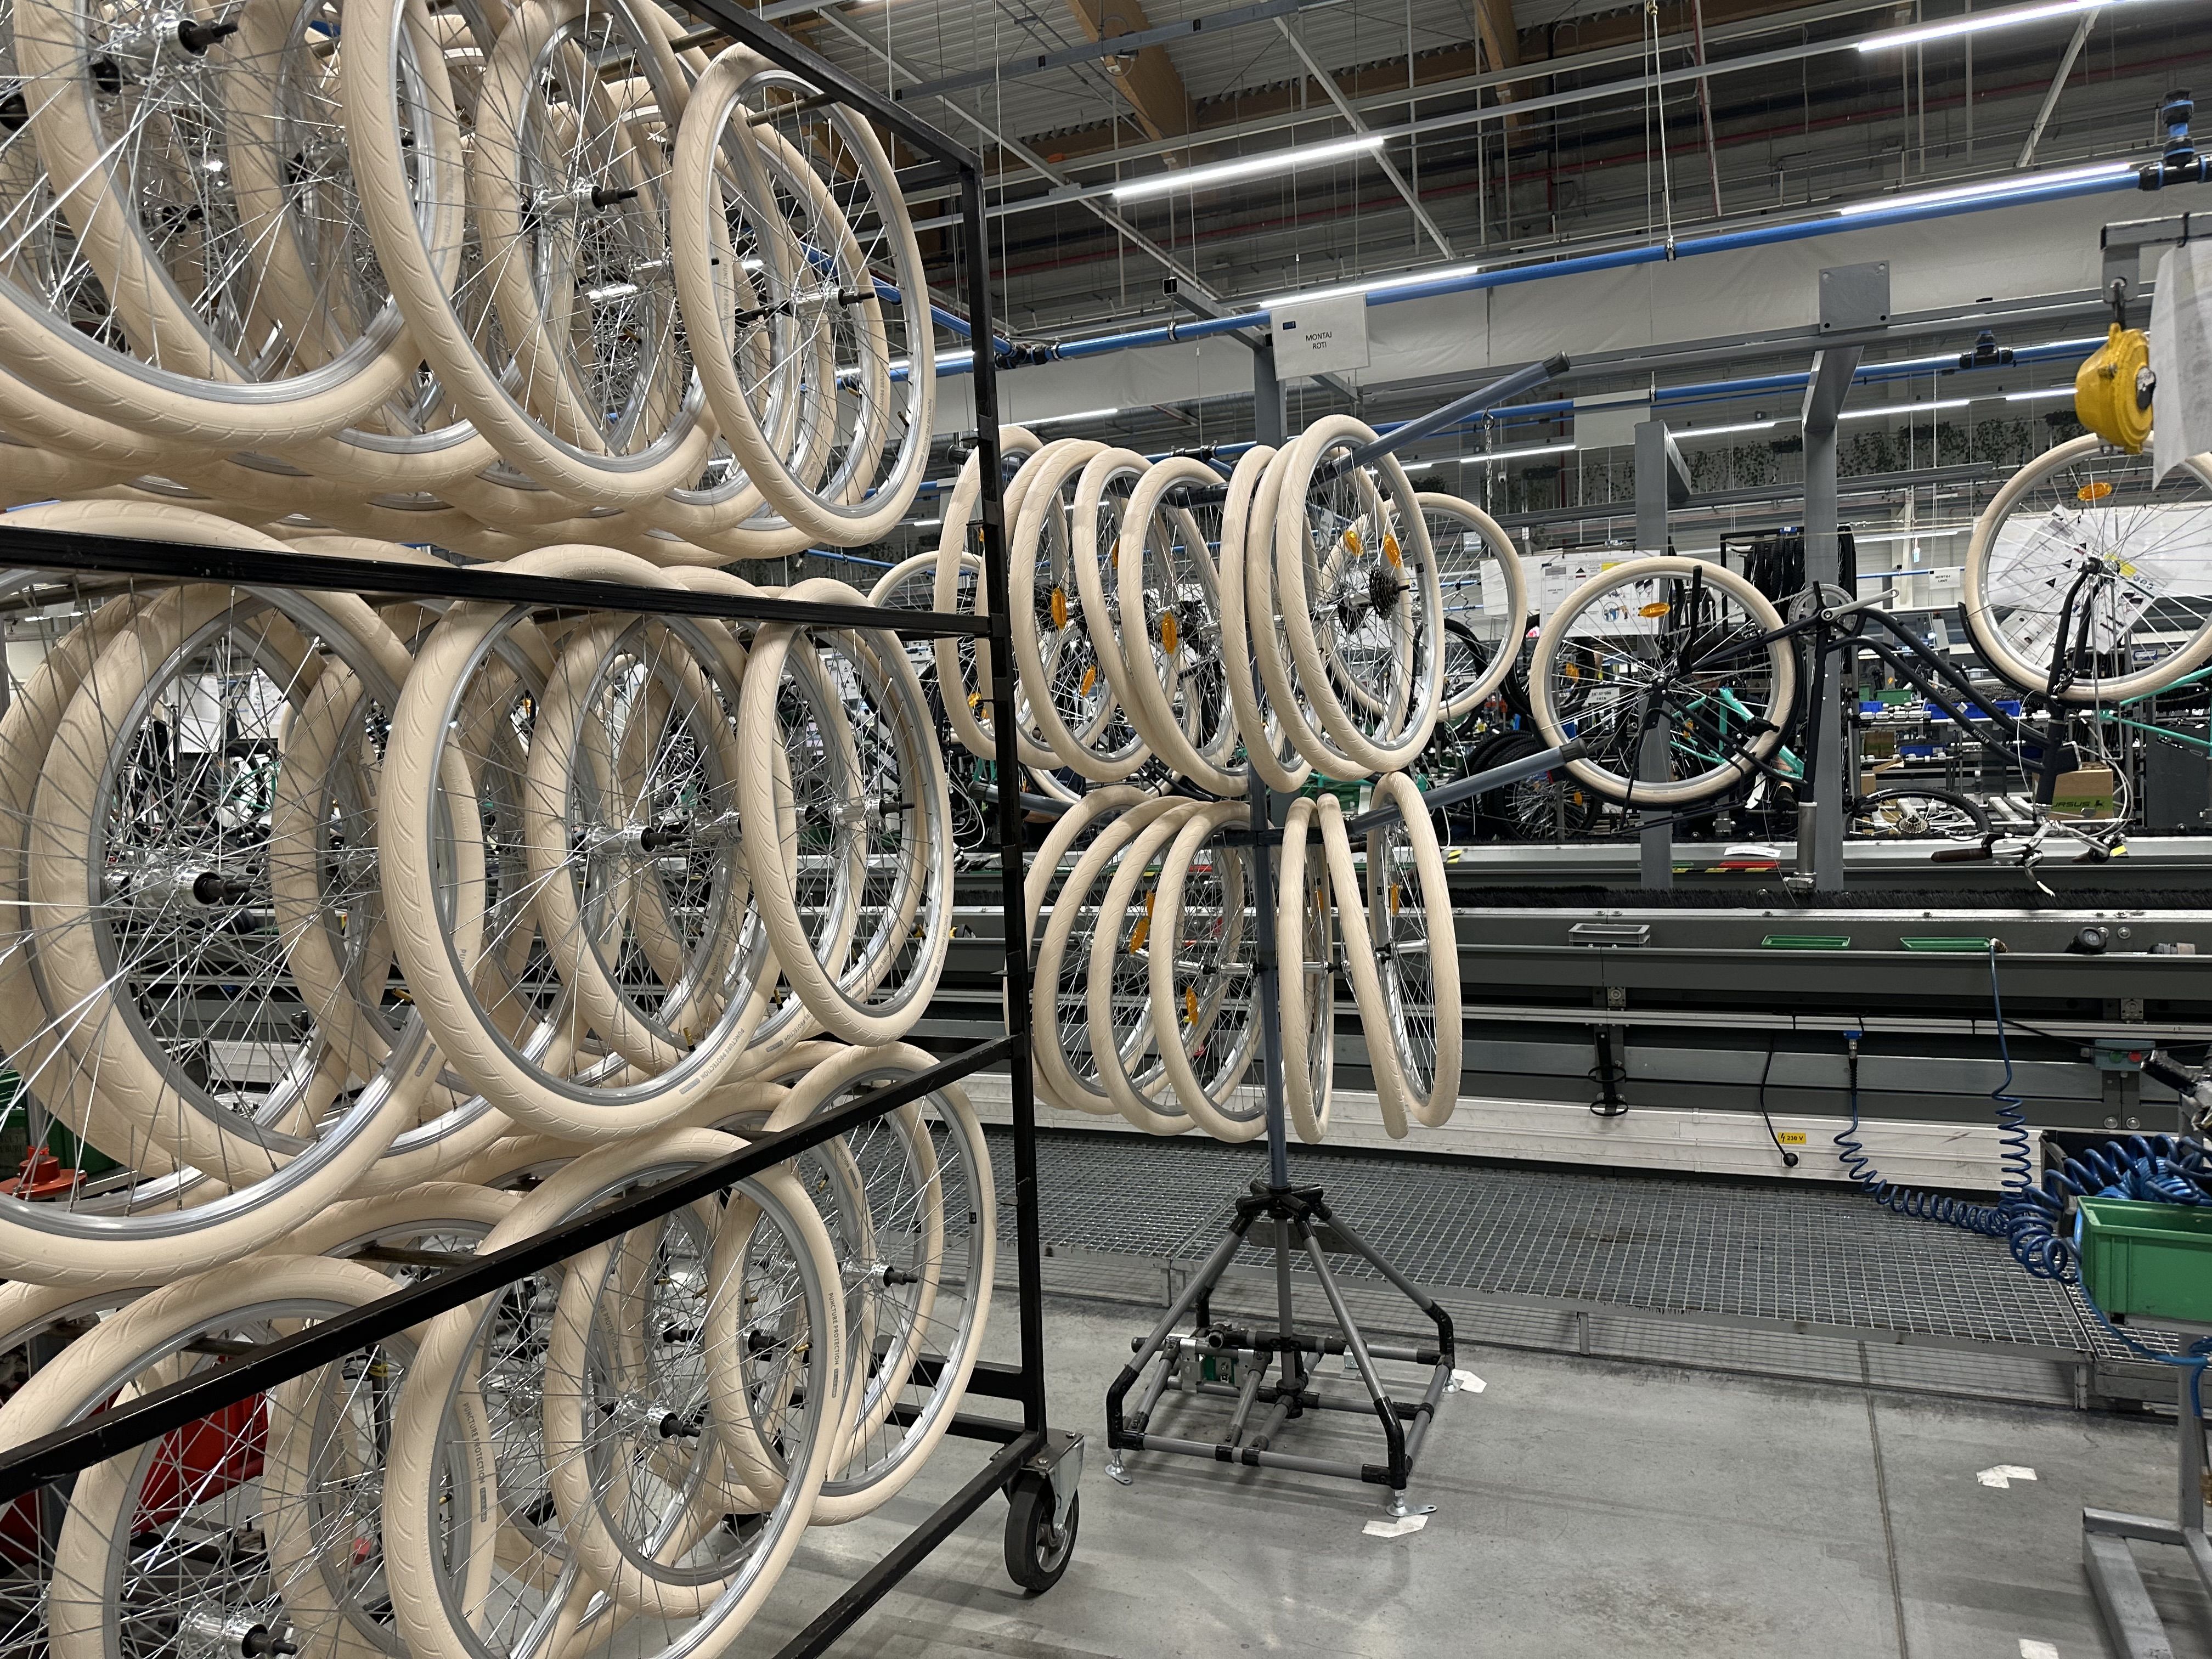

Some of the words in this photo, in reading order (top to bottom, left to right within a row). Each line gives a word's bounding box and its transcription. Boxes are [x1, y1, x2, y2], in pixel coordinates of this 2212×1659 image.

[1306, 331, 1332, 341] MONTAJ
[881, 942, 896, 964] PCTURE
[725, 1028, 745, 1054] PUNCTURE
[785, 1019, 805, 1042] PROTECTION
[700, 1052, 727, 1080] PROTECTION
[828, 1293, 838, 1324] PUNCTURE
[463, 1402, 478, 1438] PUNCTURE
[473, 1437, 486, 1484] PROTECTION
